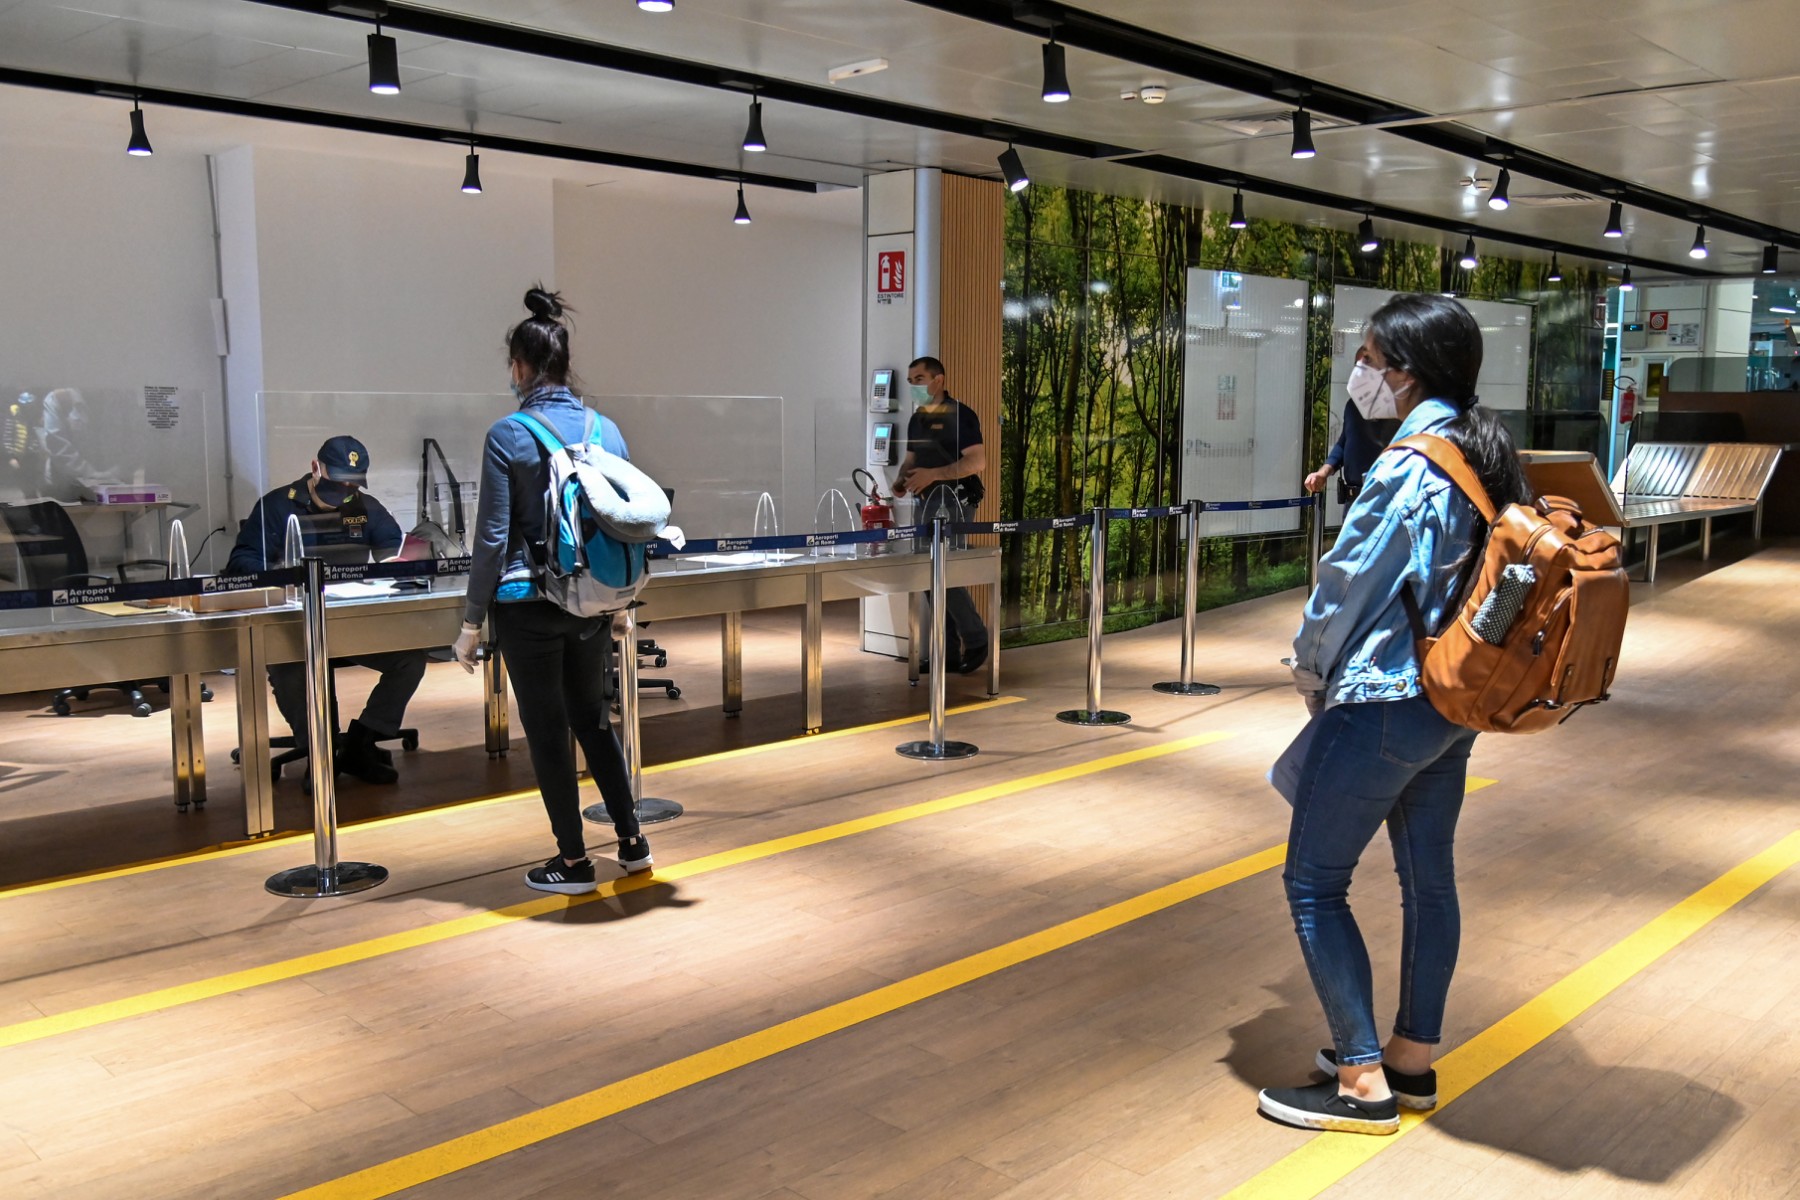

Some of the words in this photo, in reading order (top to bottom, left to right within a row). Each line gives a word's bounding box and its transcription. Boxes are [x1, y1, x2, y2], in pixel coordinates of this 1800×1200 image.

[332, 565, 368, 573] Aeroporti
[217, 574, 258, 584] Aeroporti
[69, 586, 115, 597] Aeroporti
